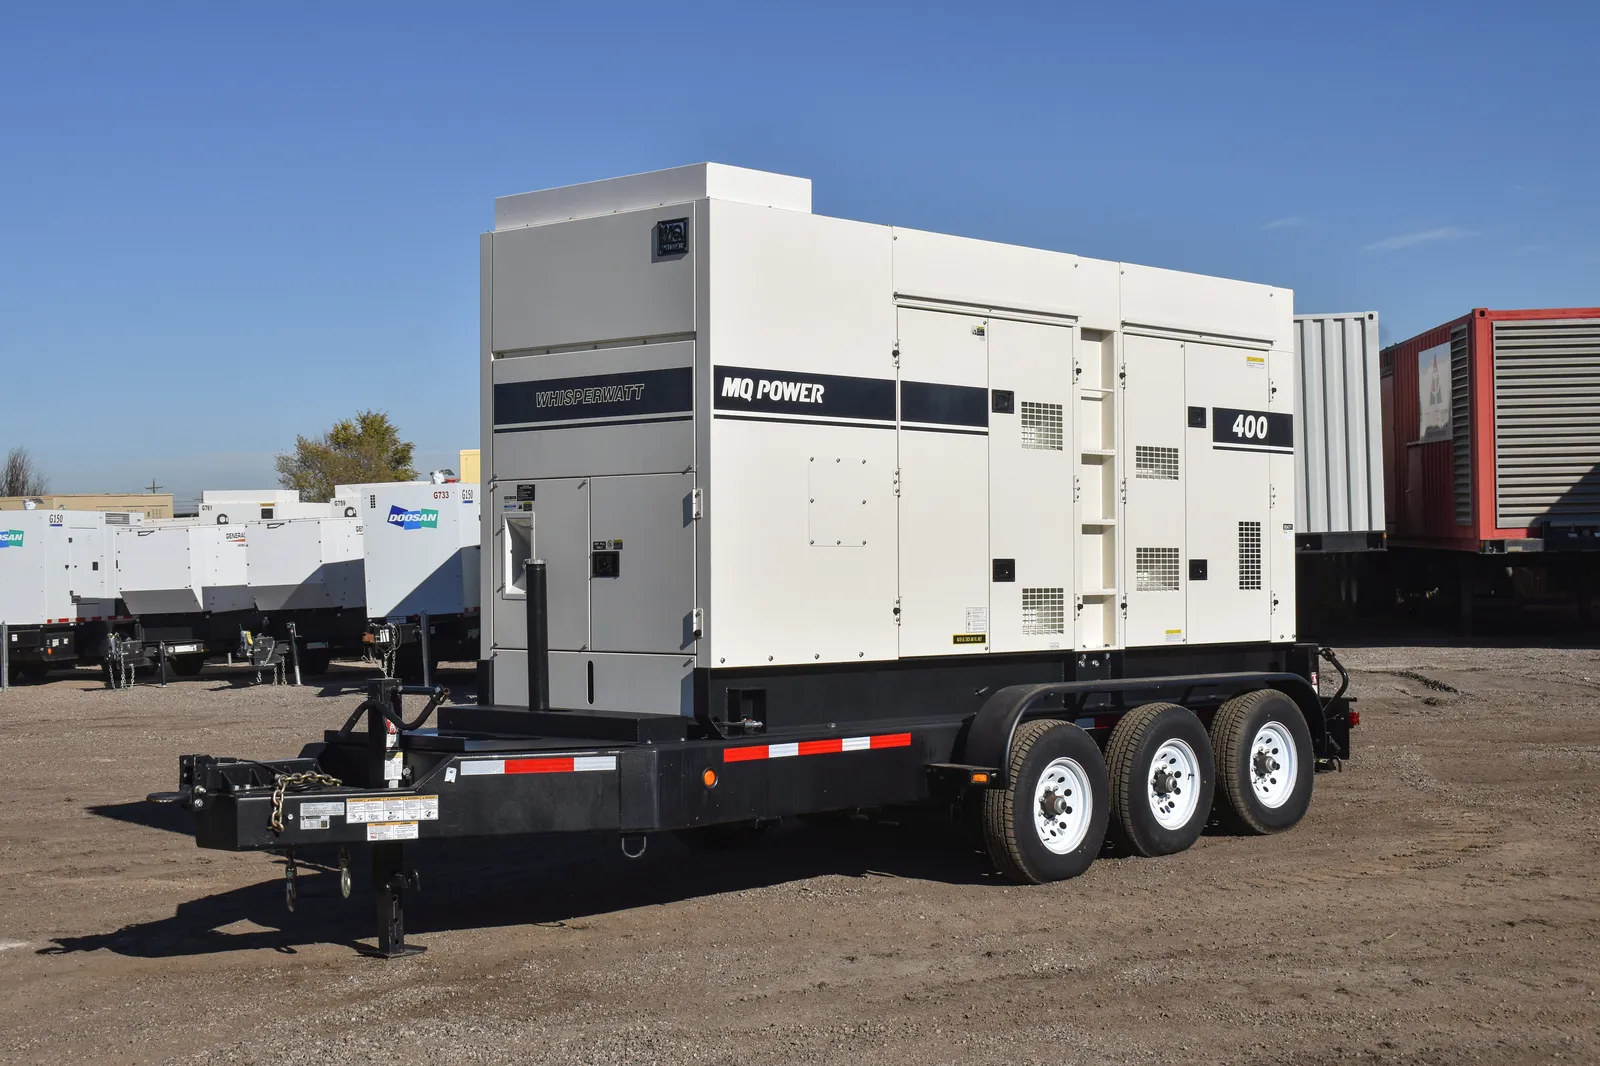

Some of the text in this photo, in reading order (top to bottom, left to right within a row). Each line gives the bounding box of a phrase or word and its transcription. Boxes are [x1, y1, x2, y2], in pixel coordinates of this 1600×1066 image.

[536, 383, 645, 408] WHISPERWATT
[721, 376, 825, 404] MQ POWER
[1232, 414, 1268, 439] 400
[433, 491, 450, 500] G733
[461, 489, 474, 500] G150
[49, 513, 64, 524] G150
[388, 513, 438, 523] DOOSAN
